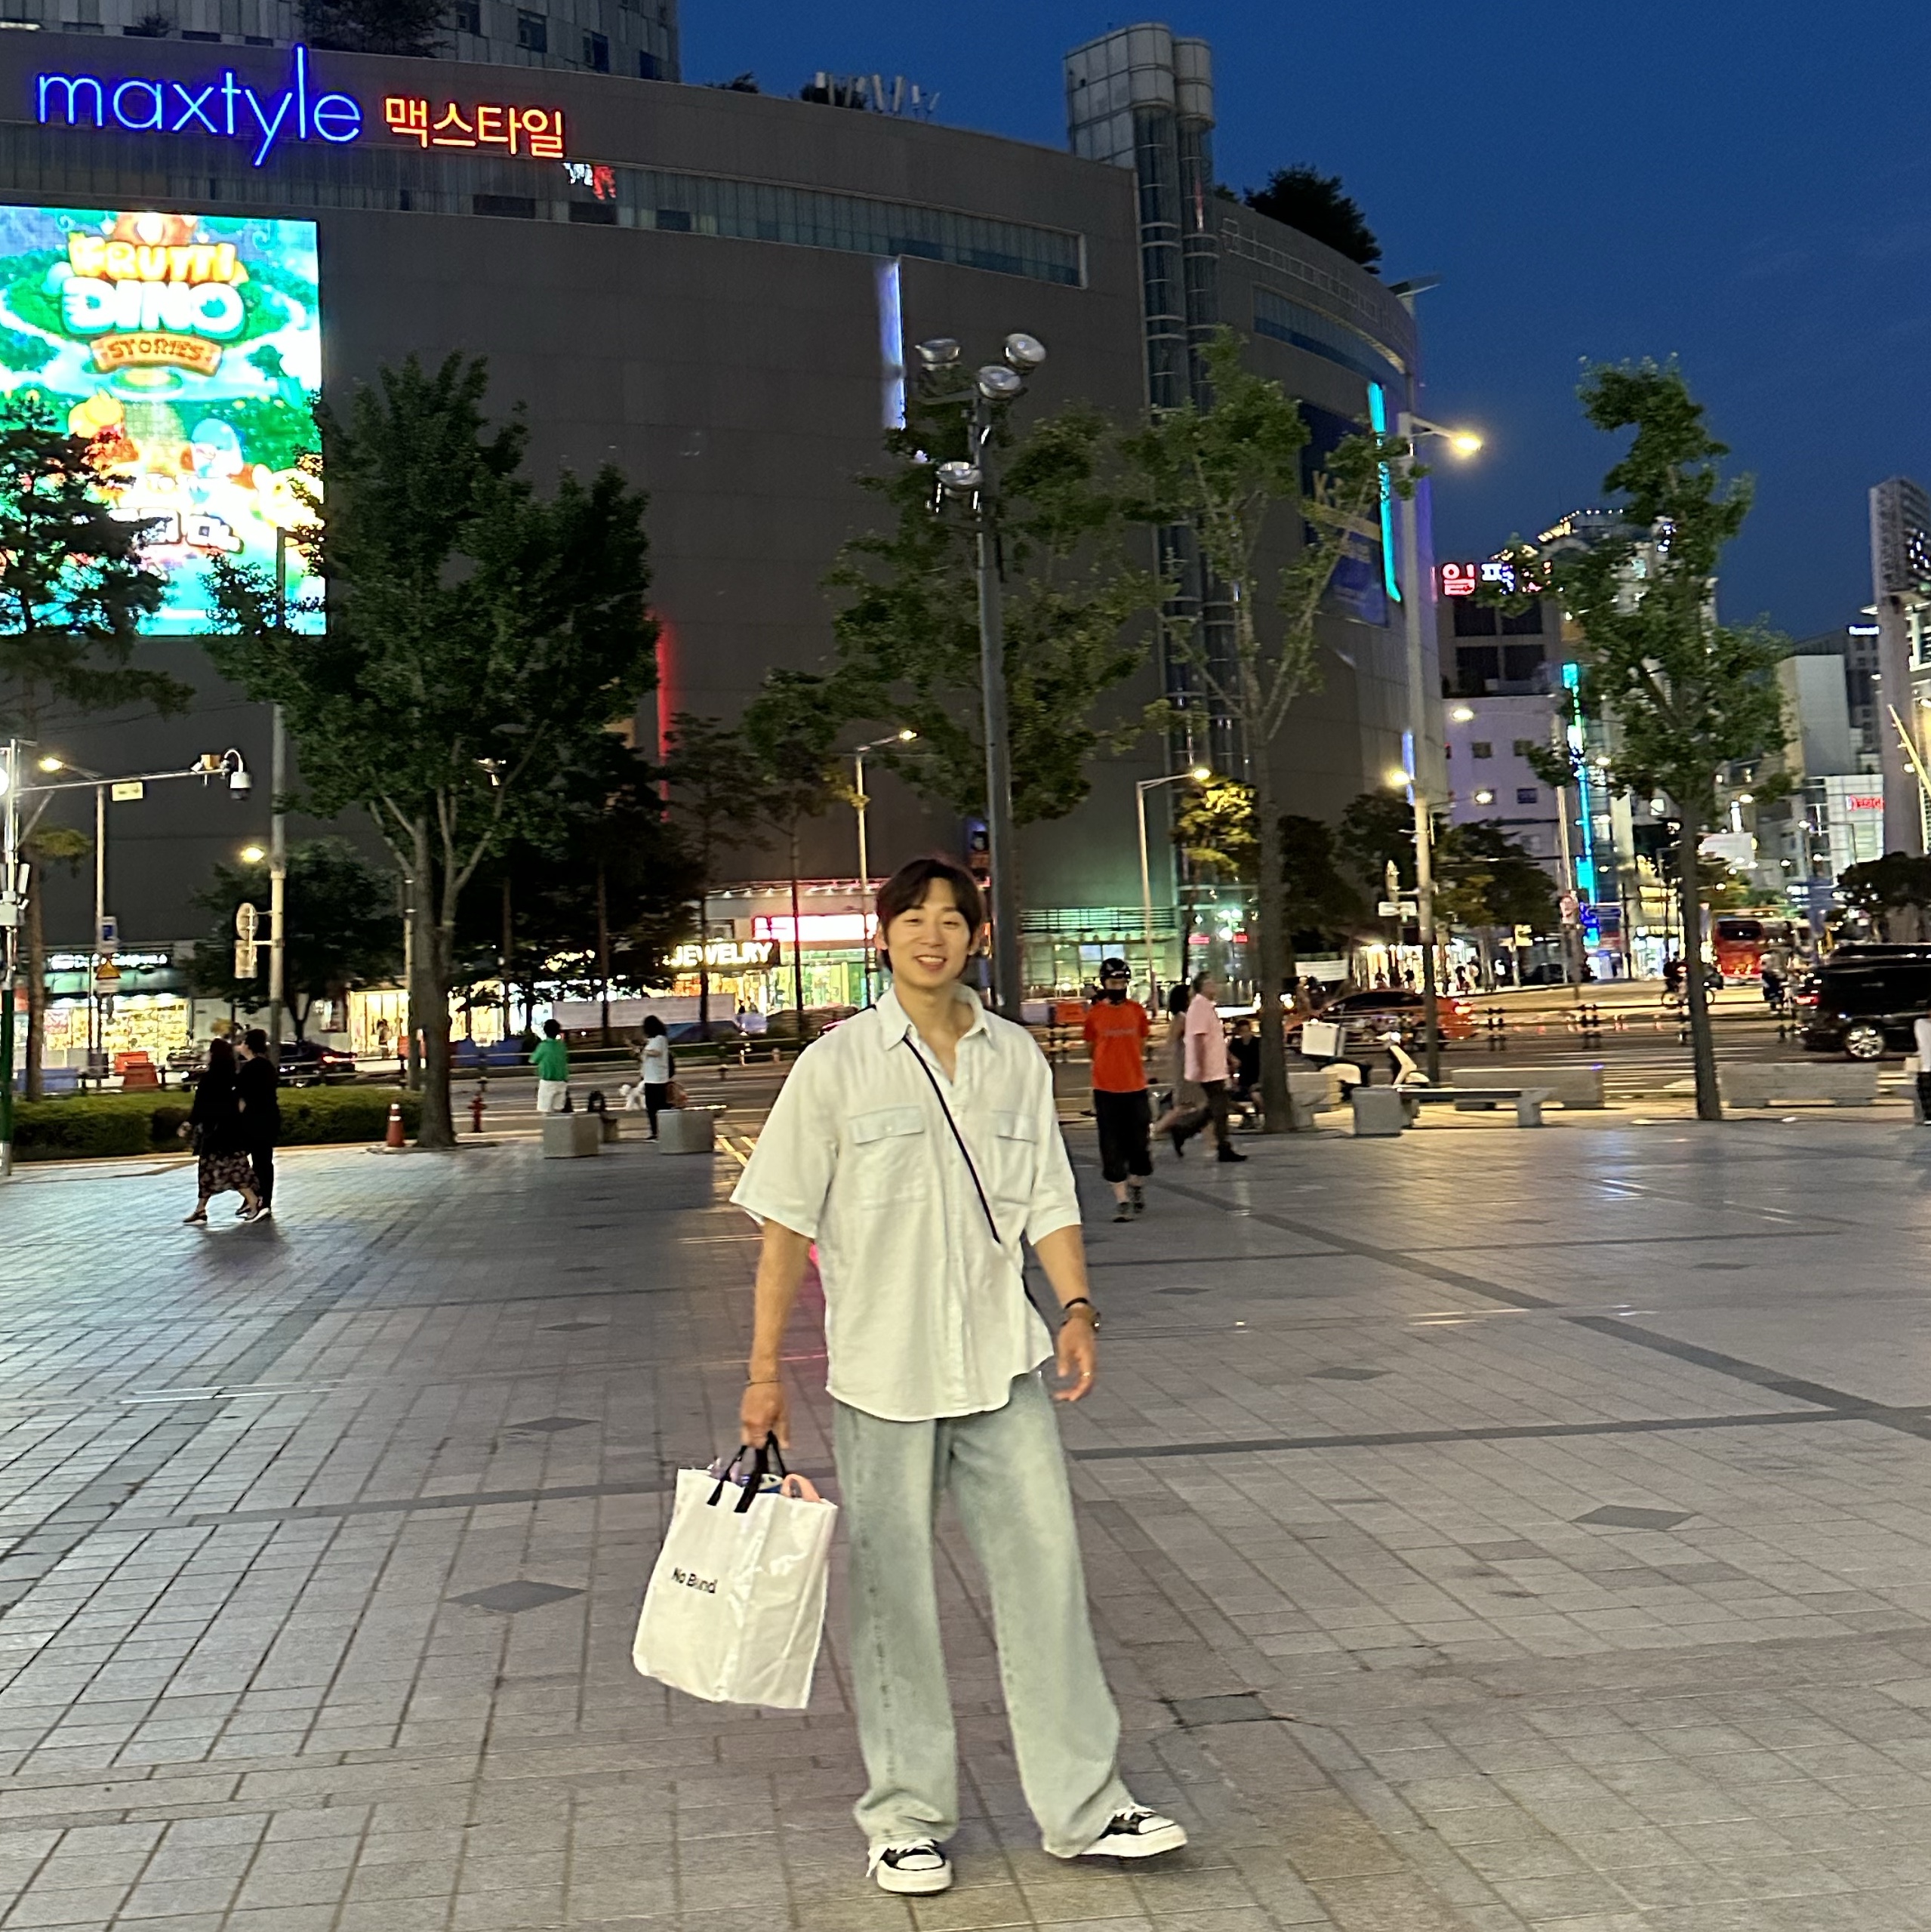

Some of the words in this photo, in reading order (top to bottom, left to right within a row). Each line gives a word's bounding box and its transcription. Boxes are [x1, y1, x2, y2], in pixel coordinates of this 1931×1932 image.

[37, 44, 362, 167] maxtyle
[384, 96, 565, 160] 맥스타일
[69, 236, 236, 282] FRUTTI
[63, 276, 245, 337] DINO
[107, 337, 205, 361] STORIES
[670, 941, 773, 967] JEWELRY
